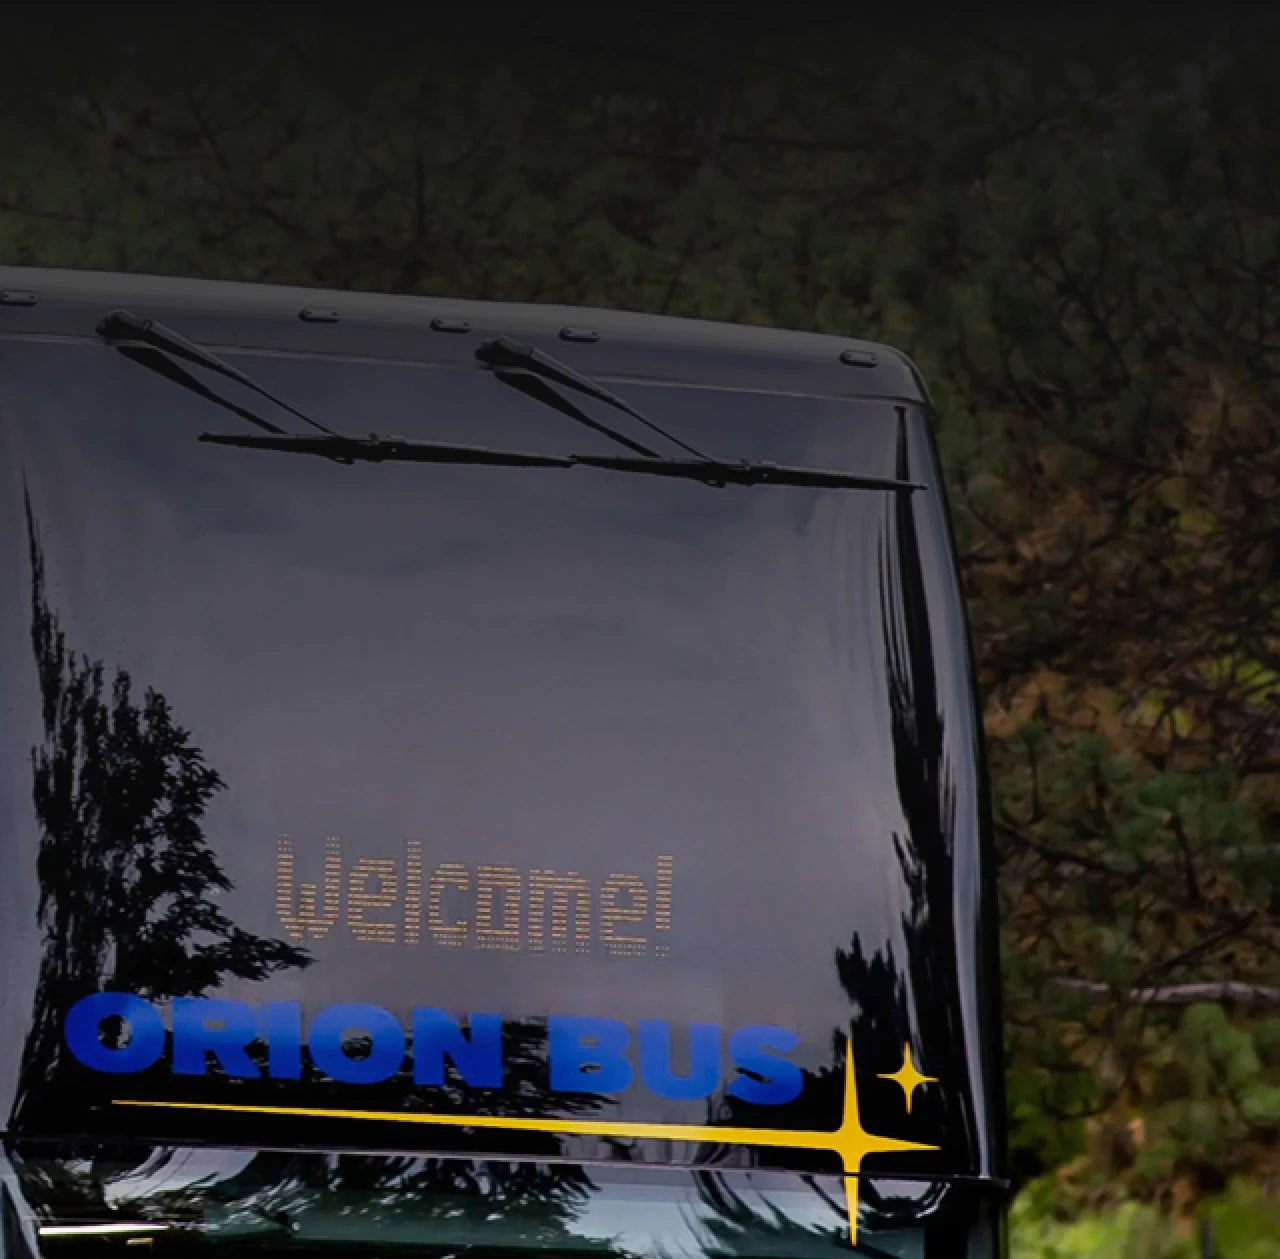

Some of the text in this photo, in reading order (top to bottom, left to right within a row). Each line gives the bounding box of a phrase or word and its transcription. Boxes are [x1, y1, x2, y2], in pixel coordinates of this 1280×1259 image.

[276, 833, 675, 958] Welcome!
[63, 990, 806, 1106] ORION BUS
